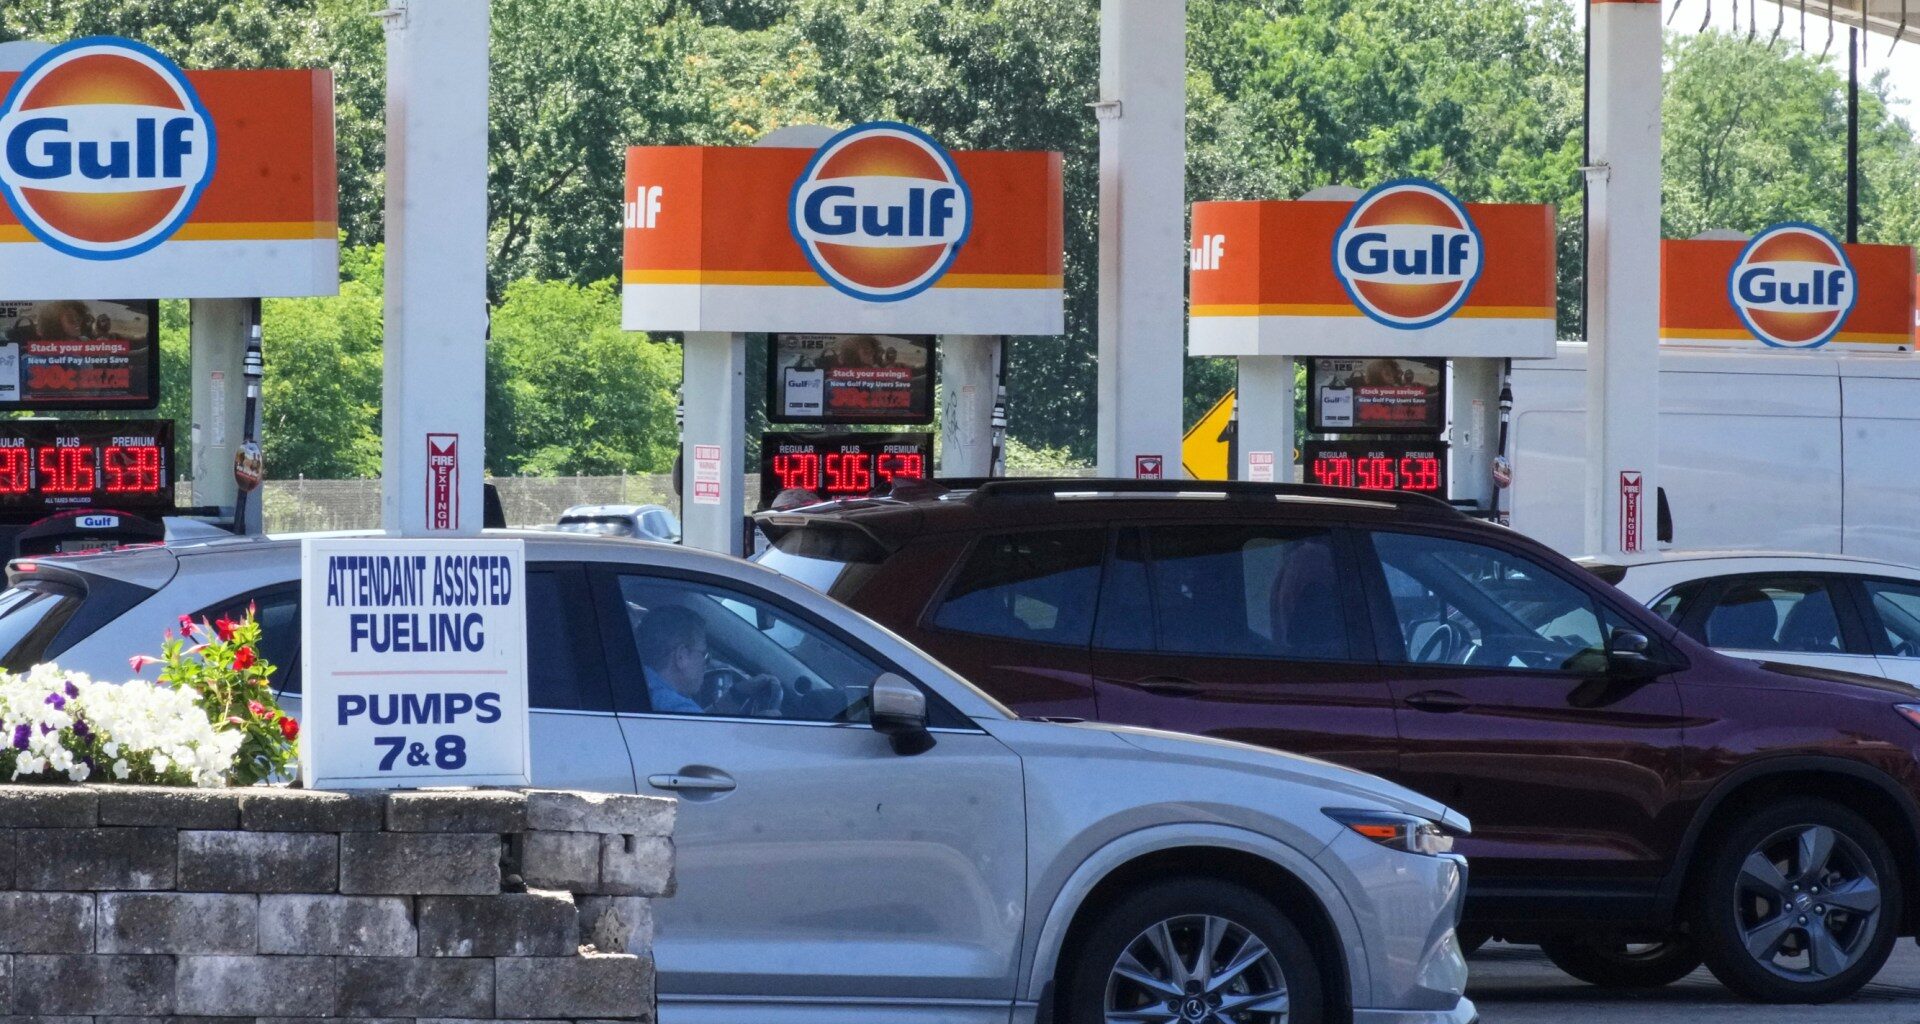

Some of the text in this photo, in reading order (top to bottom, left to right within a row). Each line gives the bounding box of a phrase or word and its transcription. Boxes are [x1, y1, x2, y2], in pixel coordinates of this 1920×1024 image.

[6, 117, 194, 180] Gulf
[625, 185, 663, 228] ulf
[804, 185, 955, 236] Gulf
[1191, 234, 1225, 270] ulf
[1344, 232, 1470, 275] Gulf
[1739, 267, 1845, 305] Gulf
[30, 342, 126, 354] Stack your savings.
[68, 357, 82, 366] Pay
[876, 370, 908, 379] savings.
[56, 437, 80, 448] PLUS
[112, 436, 155, 447] PREMIUM
[780, 444, 918, 454] REGULAR PLUS PREMIUM
[432, 456, 454, 466] FIRE
[438, 466, 447, 528] EXTINGU
[84, 517, 112, 526] Gulf
[326, 555, 512, 606] ATTENDANT ASSISTED
[350, 612, 484, 653] FUELING
[337, 692, 502, 726] PUMPS
[374, 734, 467, 771] 7&8
